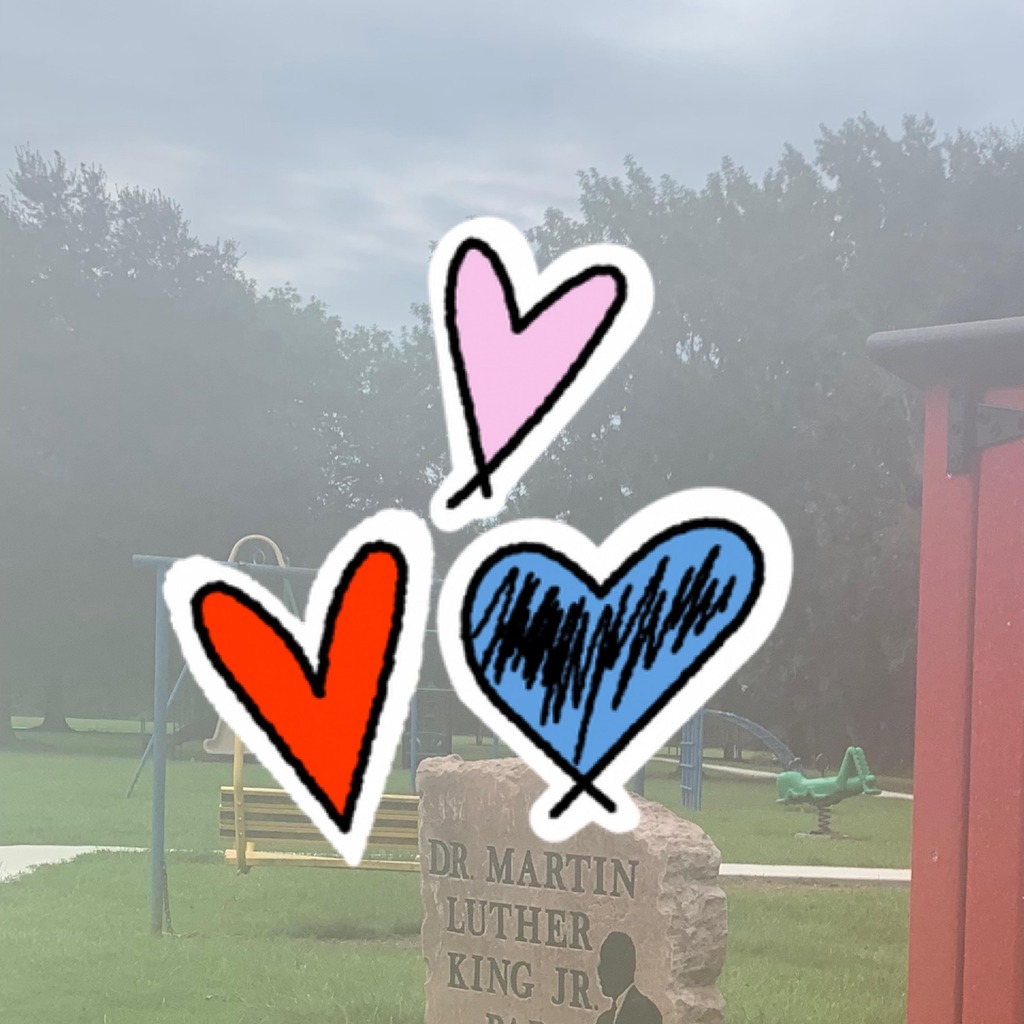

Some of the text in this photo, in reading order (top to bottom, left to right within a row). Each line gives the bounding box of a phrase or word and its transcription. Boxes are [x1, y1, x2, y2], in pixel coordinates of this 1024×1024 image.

[428, 838, 639, 899] DR. MARTIN
[446, 896, 593, 951] LUTHER
[447, 952, 599, 1011] KING JR.
